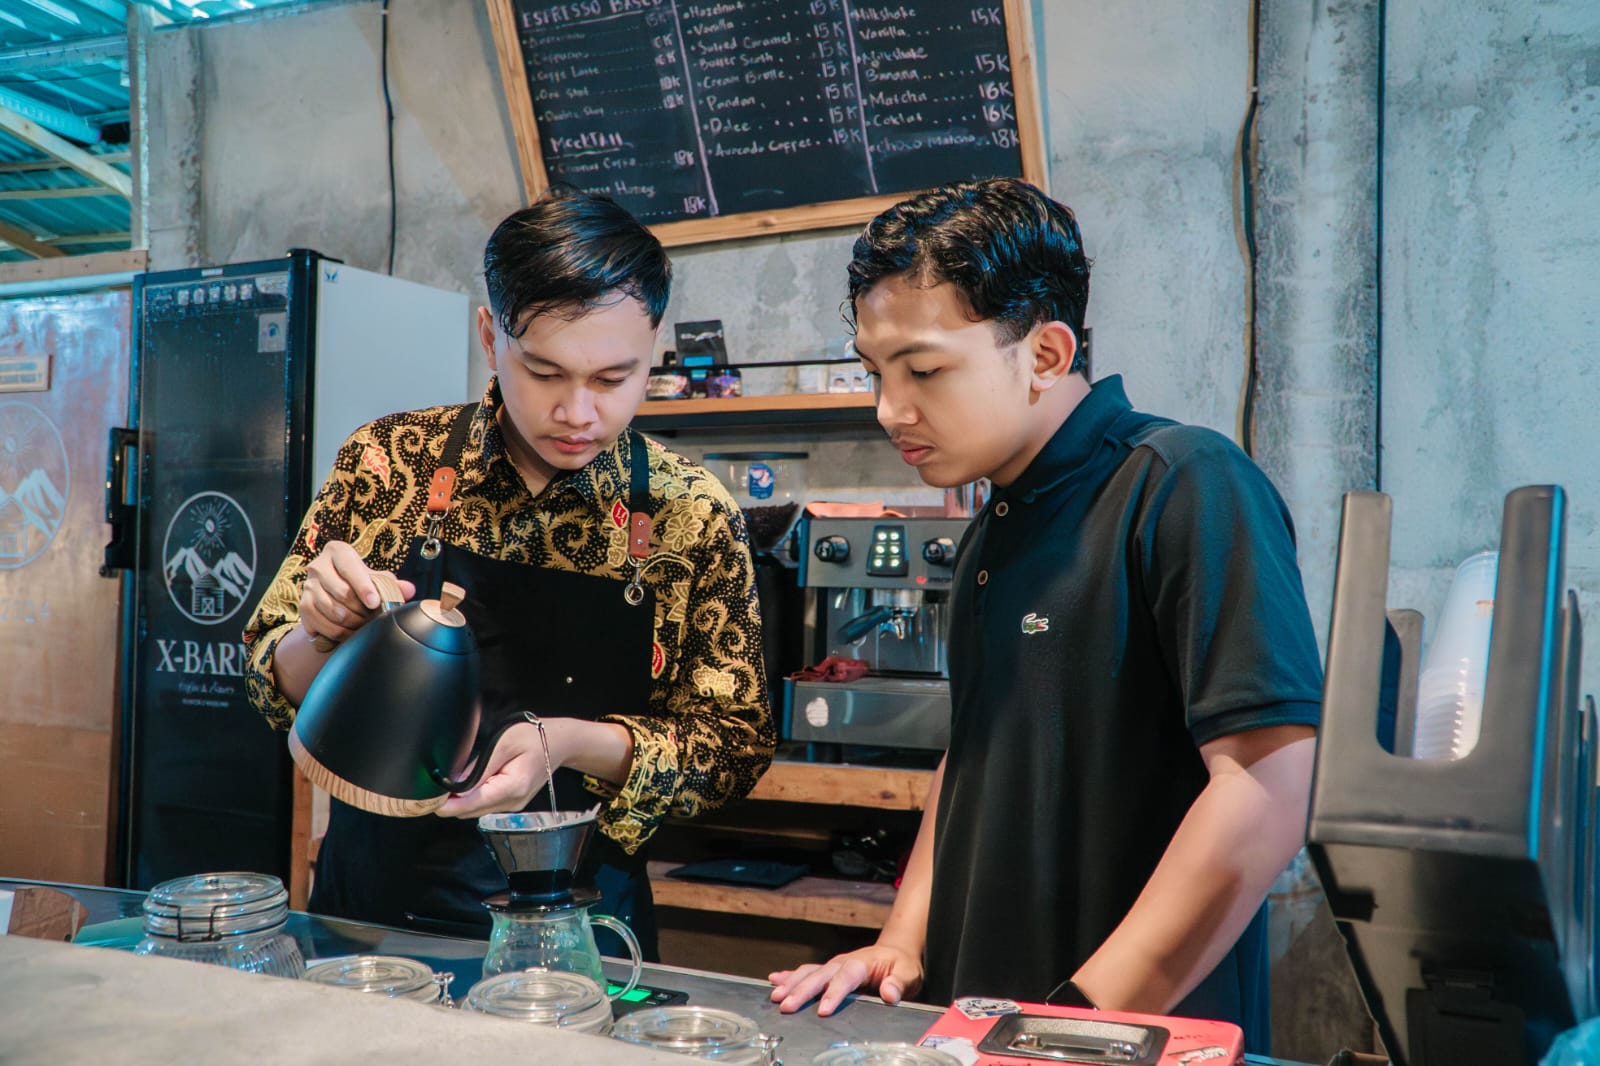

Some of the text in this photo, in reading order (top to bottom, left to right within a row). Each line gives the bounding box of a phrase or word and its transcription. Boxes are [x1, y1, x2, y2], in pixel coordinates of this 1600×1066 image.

[813, 21, 845, 38] 15K
[859, 7, 1001, 41] Vanilla 15K
[817, 41, 849, 58] 15K
[821, 61, 851, 78] 15K
[866, 53, 1010, 82] Banana 15K
[706, 82, 855, 111] Pandan 15K
[869, 81, 1014, 108] Matcha 16K
[829, 105, 857, 124] 15K
[982, 103, 1015, 123] 16K
[991, 128, 1020, 149] 18K
